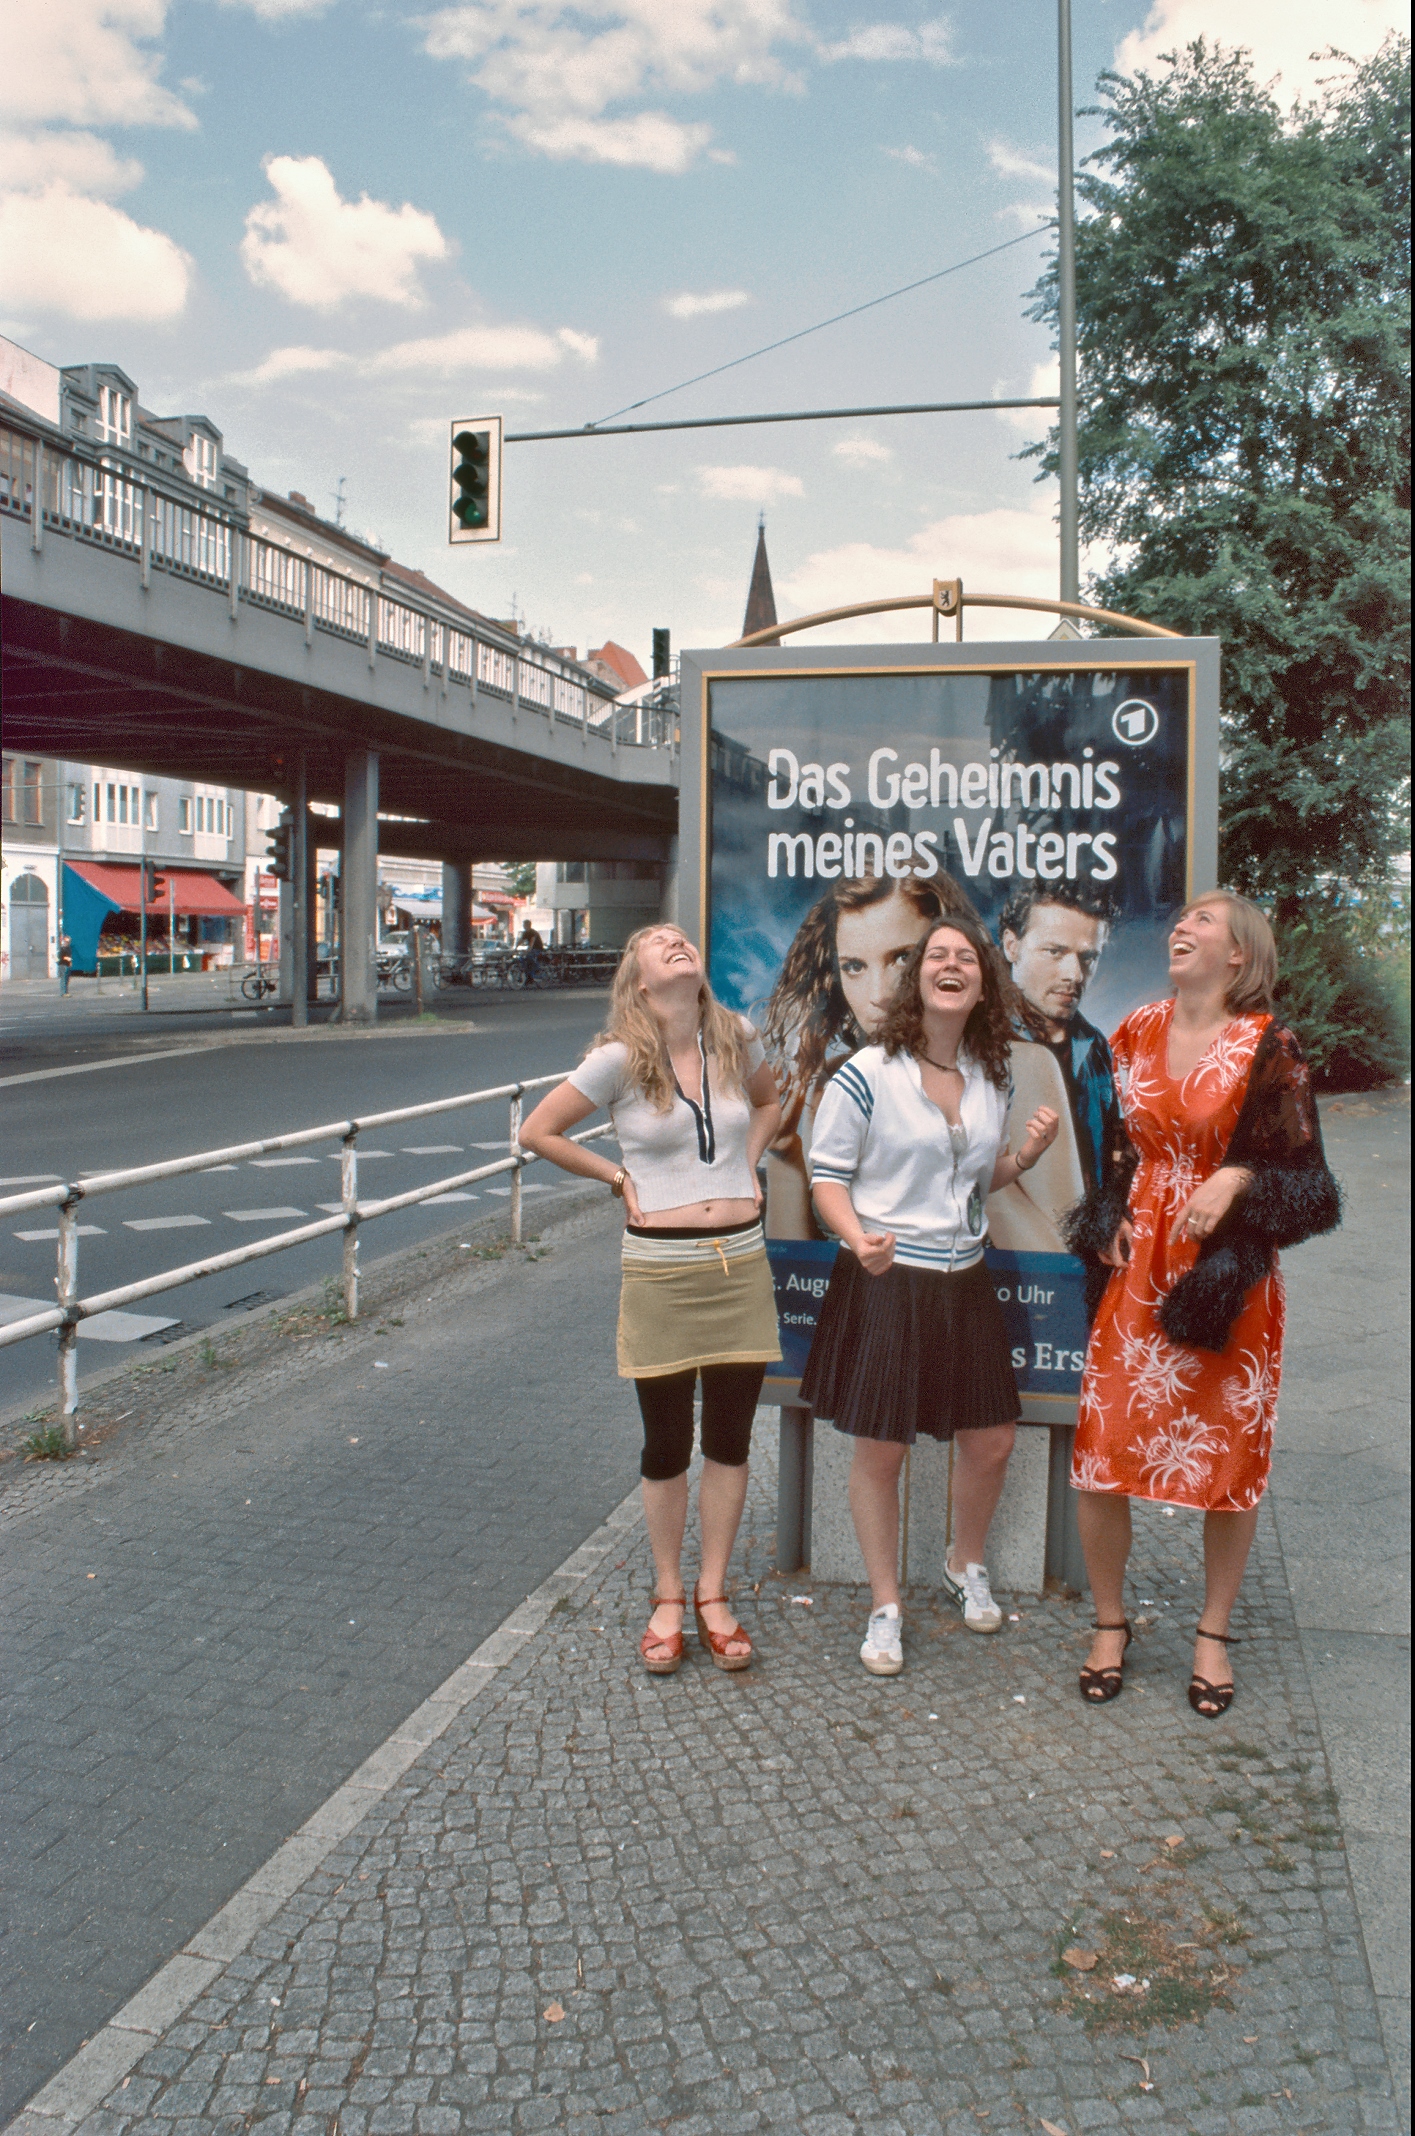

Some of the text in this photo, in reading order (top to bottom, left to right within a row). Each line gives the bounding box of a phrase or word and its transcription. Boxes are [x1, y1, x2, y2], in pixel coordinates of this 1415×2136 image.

[767, 747, 1120, 810] Das Geheimnis
[767, 817, 1117, 881] meines Vaters
[785, 1273, 830, 1298] Aug
[1017, 1284, 1055, 1305] Uhr
[783, 1311, 817, 1326] Serie.
[1011, 1342, 1085, 1372] s Ers
